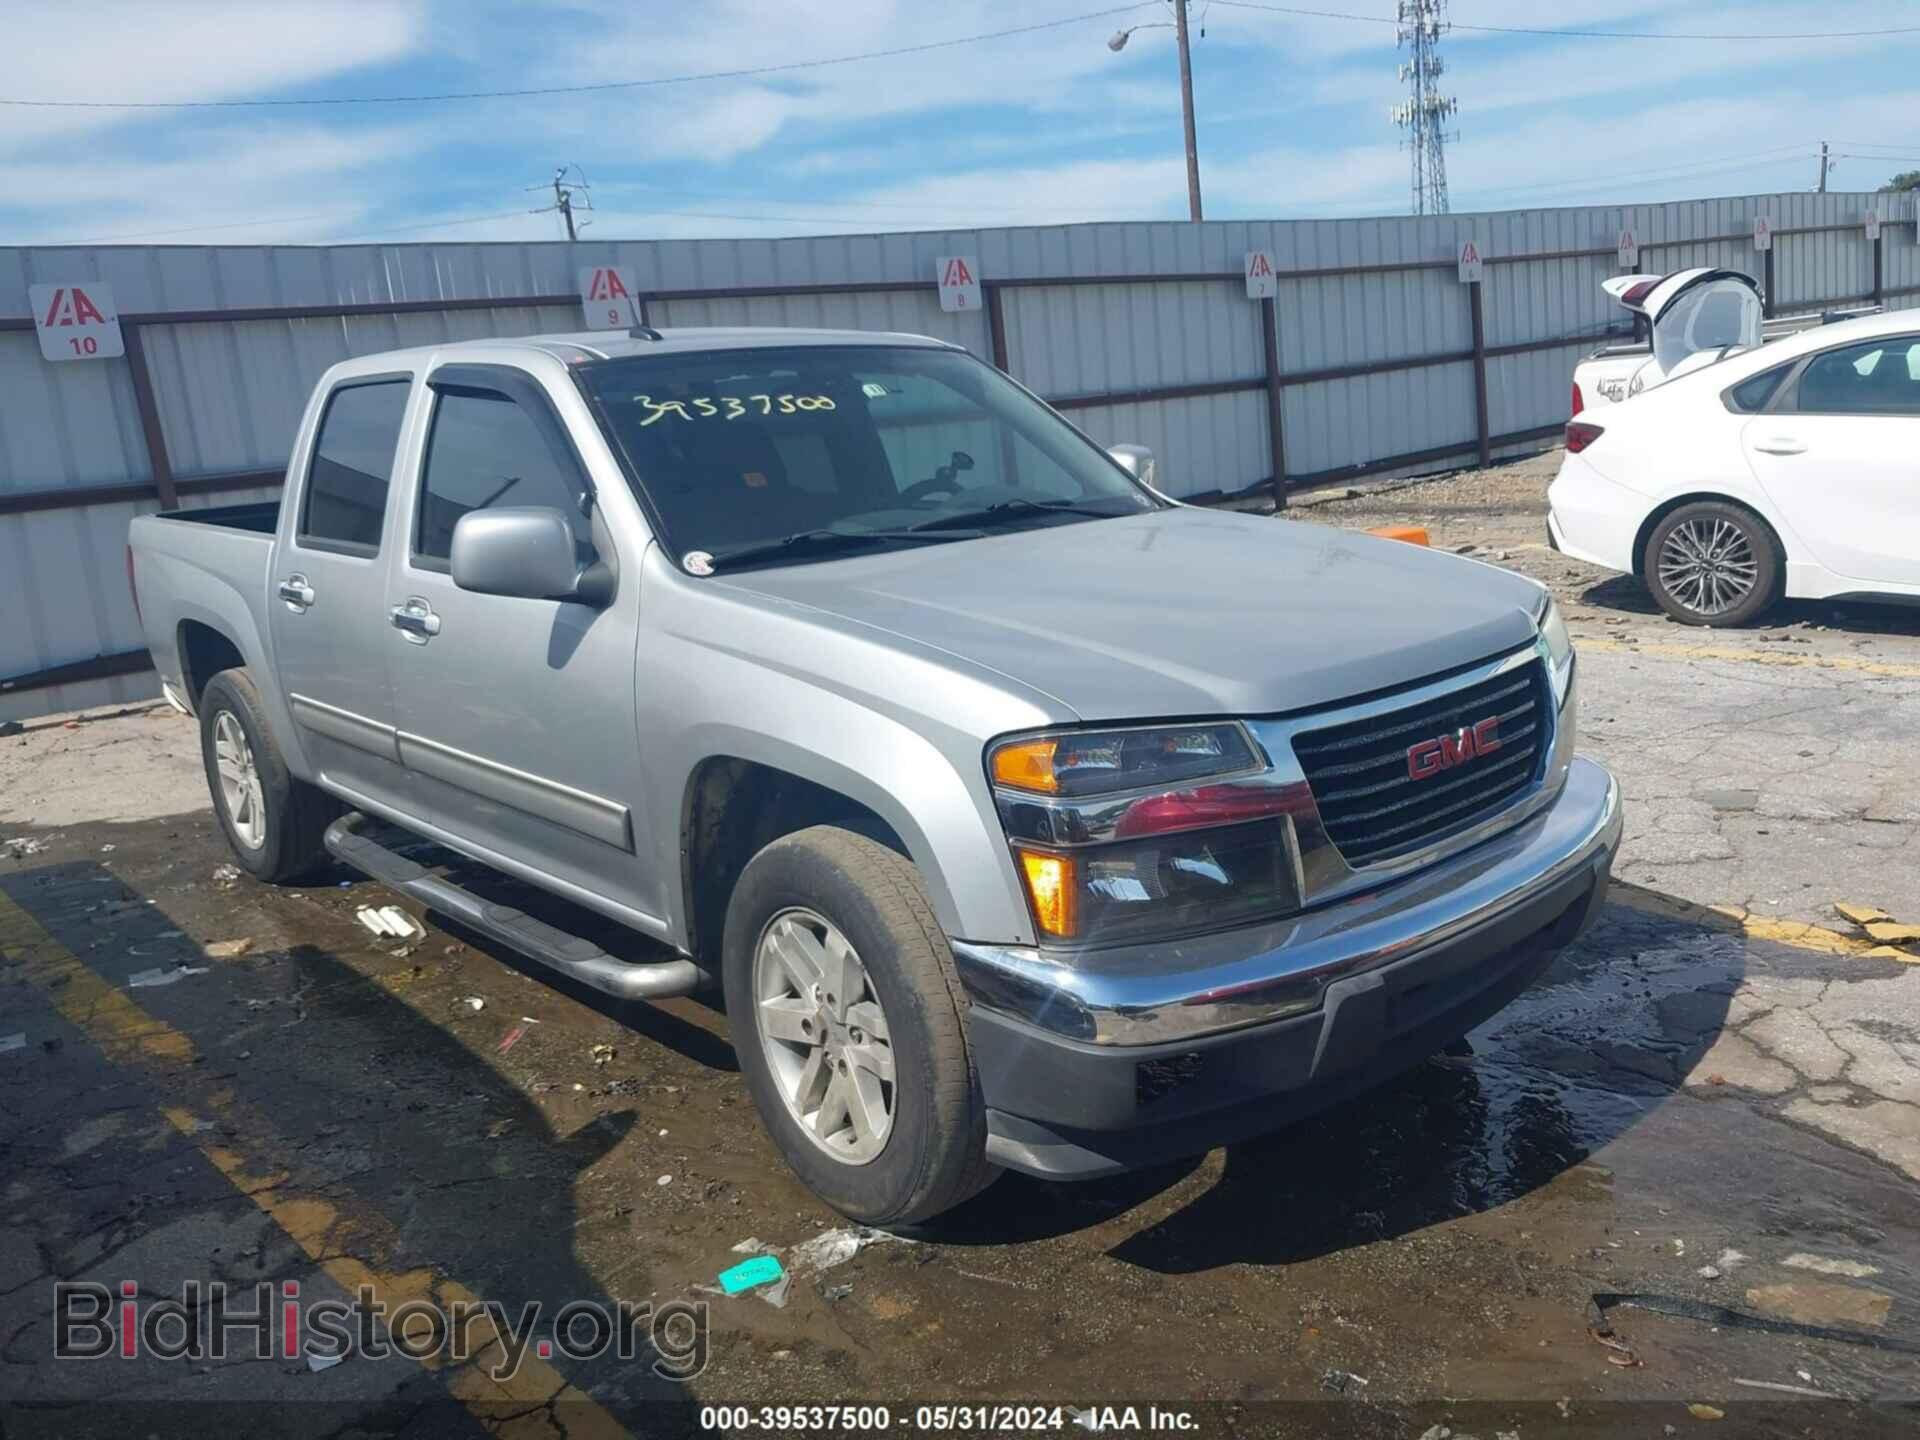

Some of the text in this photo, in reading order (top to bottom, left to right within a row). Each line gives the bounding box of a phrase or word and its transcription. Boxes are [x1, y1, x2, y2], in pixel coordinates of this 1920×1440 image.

[590, 269, 629, 301] IAA
[943, 259, 974, 286] IAA
[45, 288, 105, 327] IAA
[608, 309, 619, 325] 9
[69, 336, 97, 354] 10
[633, 395, 836, 426] 39537500
[1406, 715, 1505, 781] GMC
